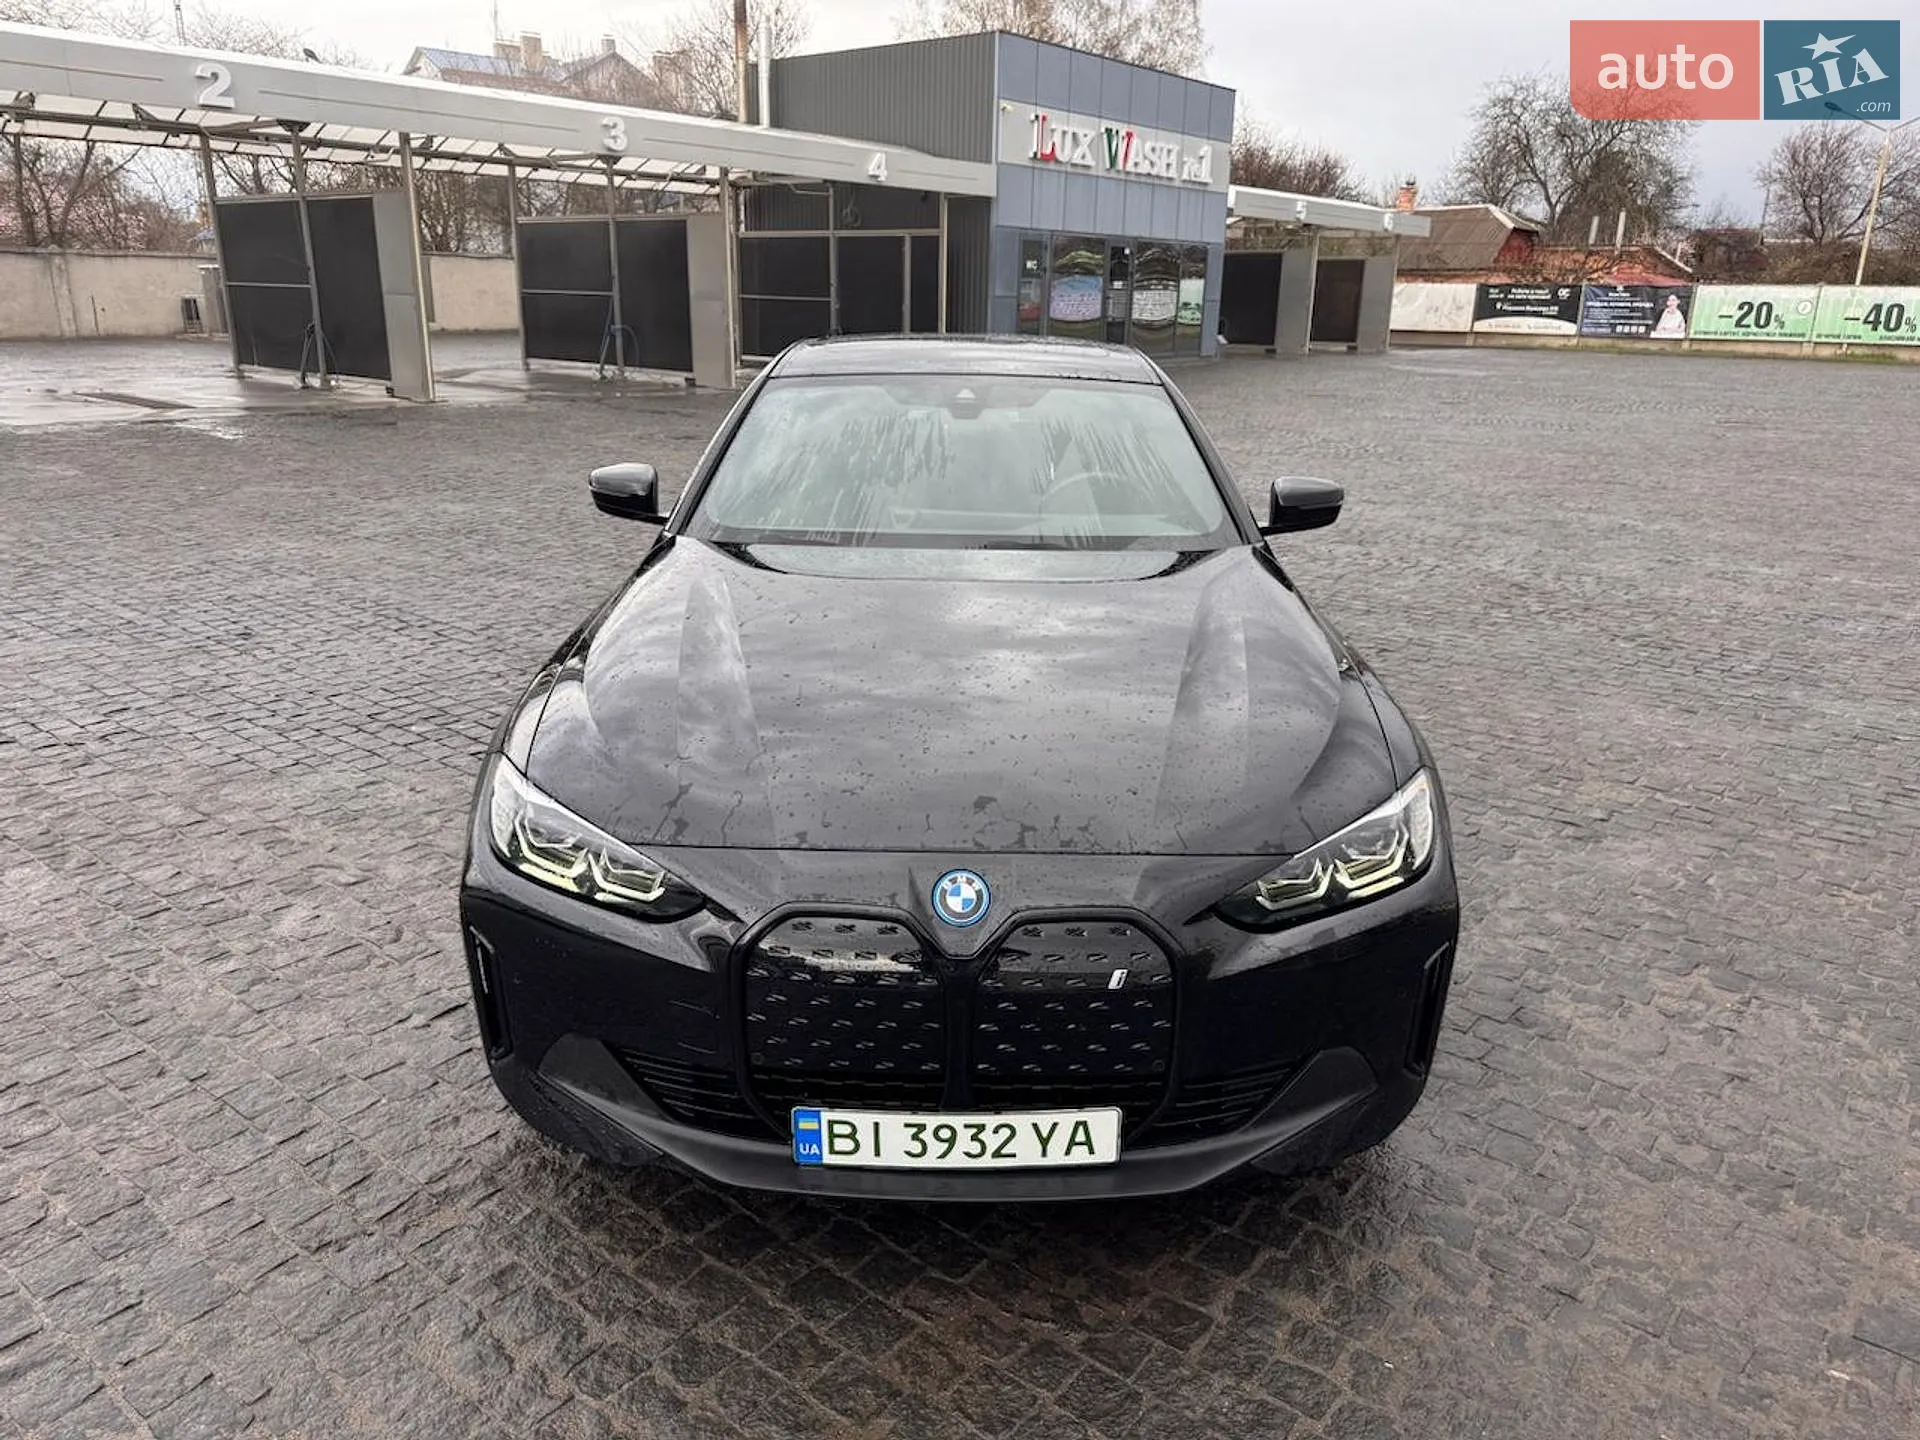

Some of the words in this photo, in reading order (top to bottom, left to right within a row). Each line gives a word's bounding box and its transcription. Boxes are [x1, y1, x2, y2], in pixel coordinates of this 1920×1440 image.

[194, 62, 236, 109] 2
[601, 116, 629, 152] 3
[867, 152, 889, 182] 4
[1718, 301, 1785, 330] -20%
[1844, 303, 1918, 334] -40%
[799, 1143, 820, 1157] UA
[827, 1119, 881, 1158] BI
[903, 1121, 1017, 1160] 3932
[1031, 1119, 1096, 1158] YA
